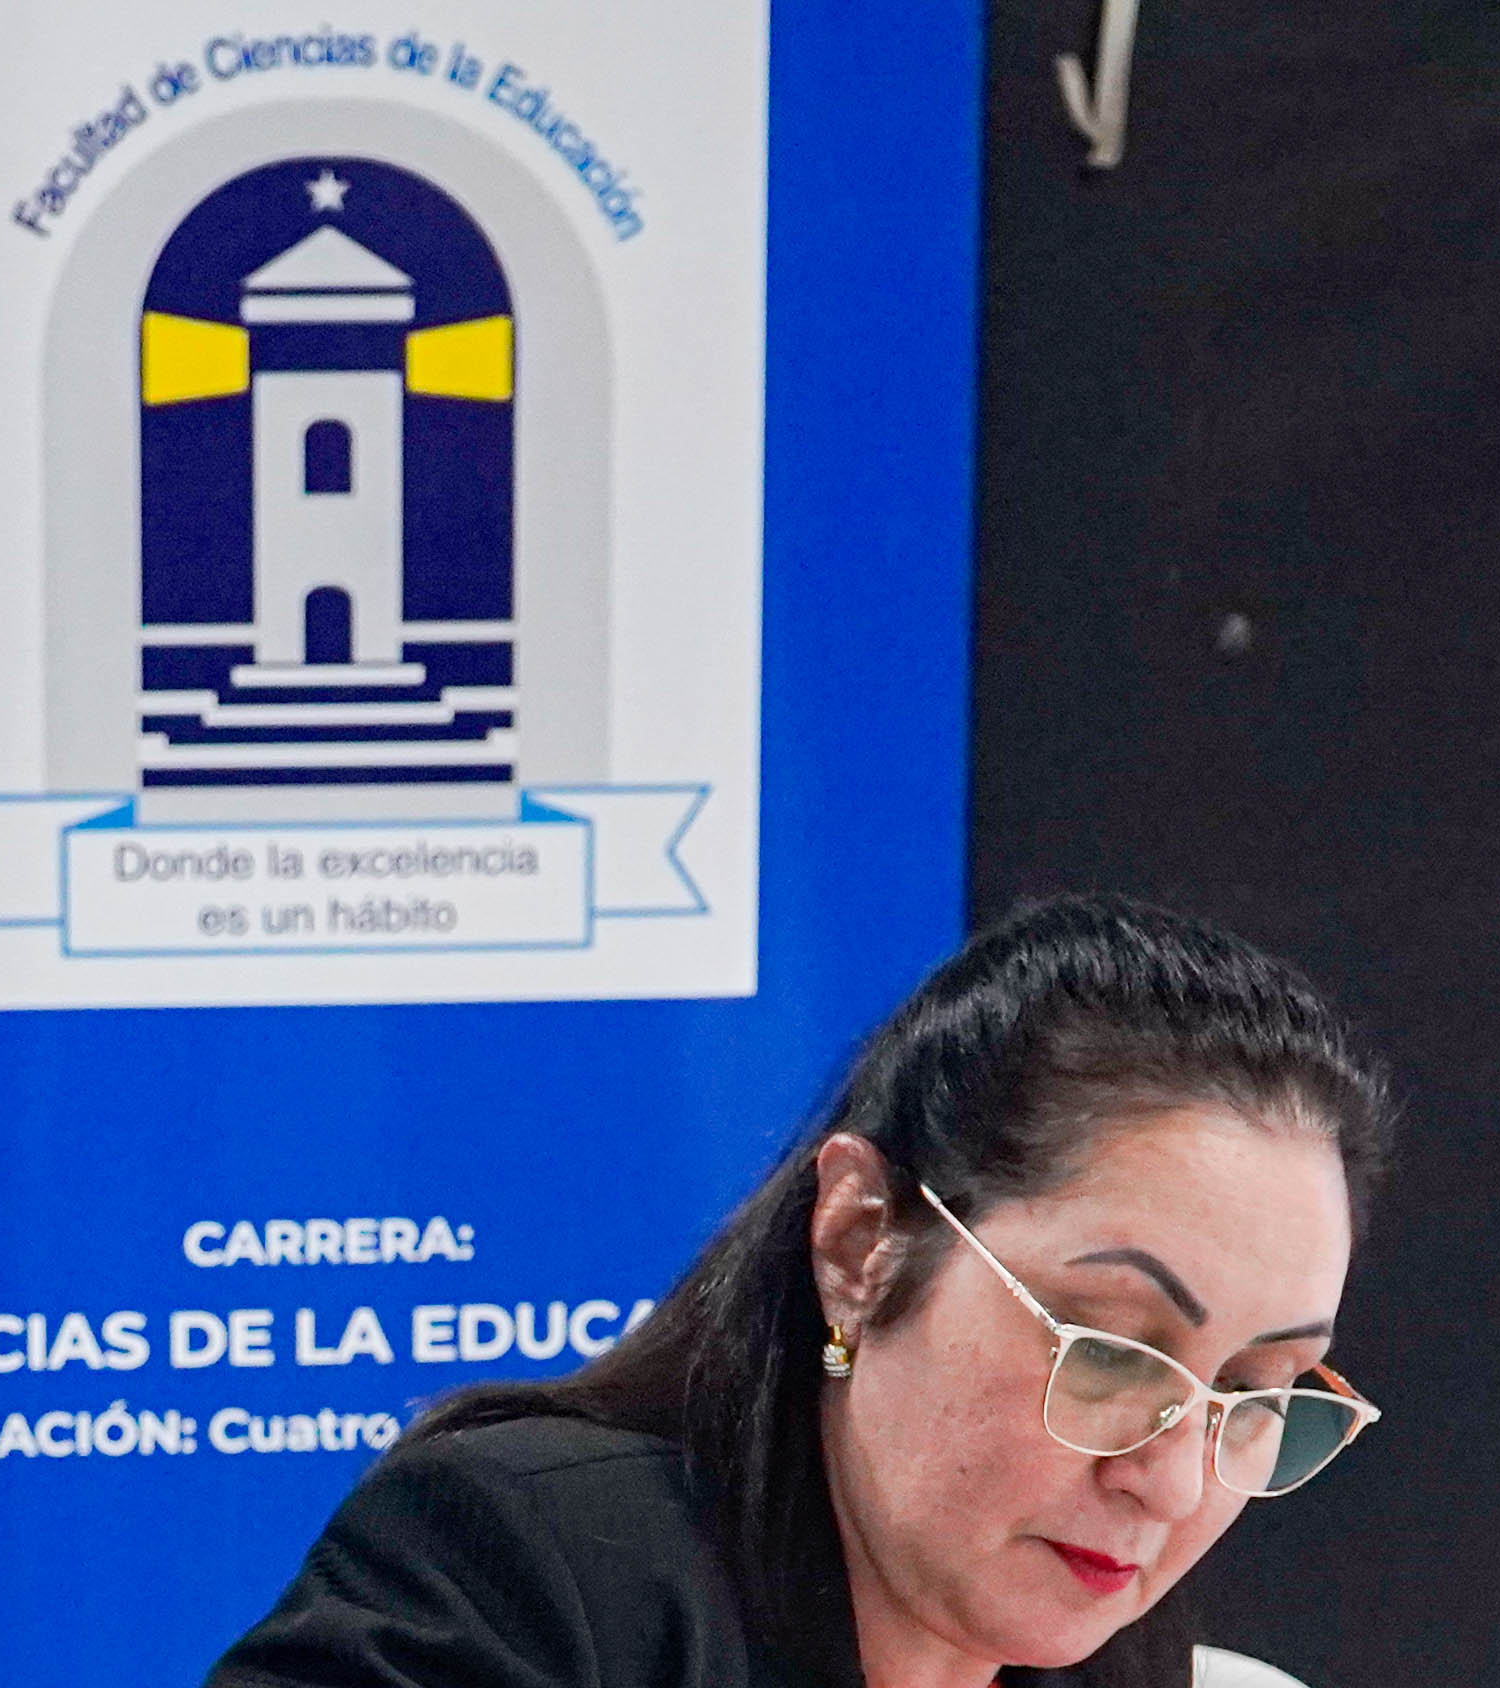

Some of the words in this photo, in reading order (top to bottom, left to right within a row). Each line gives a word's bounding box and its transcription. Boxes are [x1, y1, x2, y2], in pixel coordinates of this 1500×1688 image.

[11, 84, 148, 238] Facultad
[149, 59, 198, 107] de
[204, 23, 375, 82] Ciencias
[388, 31, 439, 76] de
[450, 42, 485, 90] la
[487, 60, 644, 243] Educación
[114, 840, 254, 882] Donde
[267, 843, 303, 879] la
[318, 836, 539, 879] excelencia
[198, 904, 249, 935] es
[262, 903, 314, 934] un
[327, 894, 458, 933] hábito
[182, 1215, 475, 1268] CARRERA:
[169, 1308, 275, 1368] DE
[295, 1305, 395, 1366] LA
[208, 1407, 400, 1455] Cuatro
